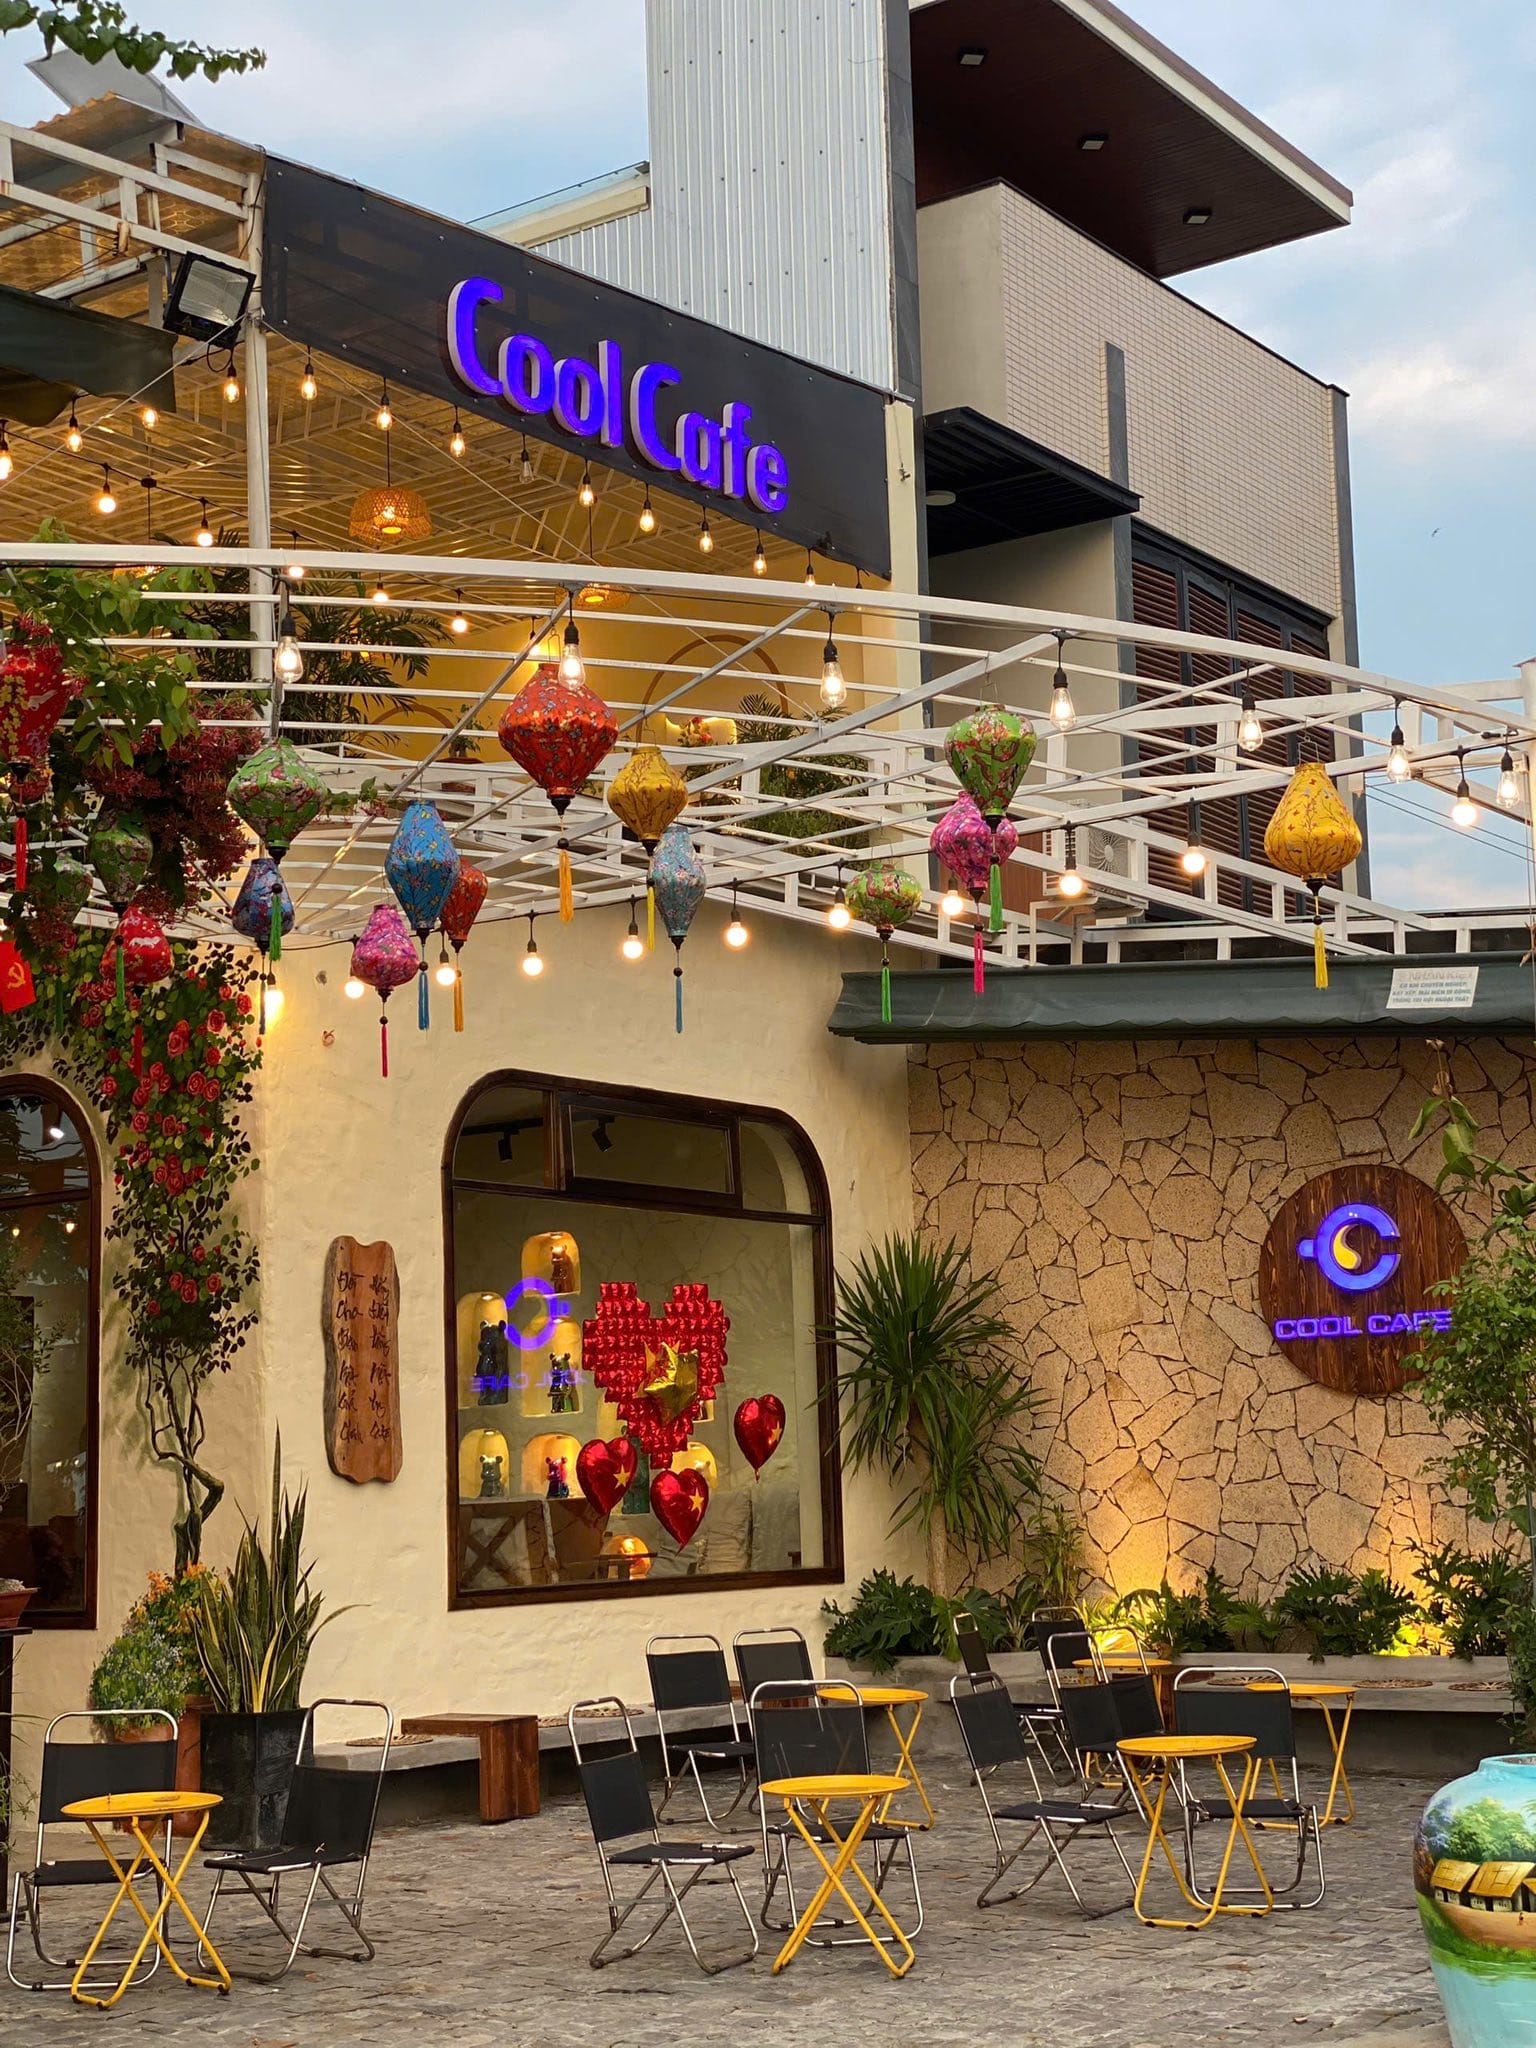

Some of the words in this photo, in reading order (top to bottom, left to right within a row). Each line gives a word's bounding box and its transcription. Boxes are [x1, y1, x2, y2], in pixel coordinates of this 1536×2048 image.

[447, 276, 622, 448] Cool
[629, 362, 789, 513] Cafe
[1275, 1316, 1363, 1340] COOL
[1367, 1309, 1452, 1334] CAFE
